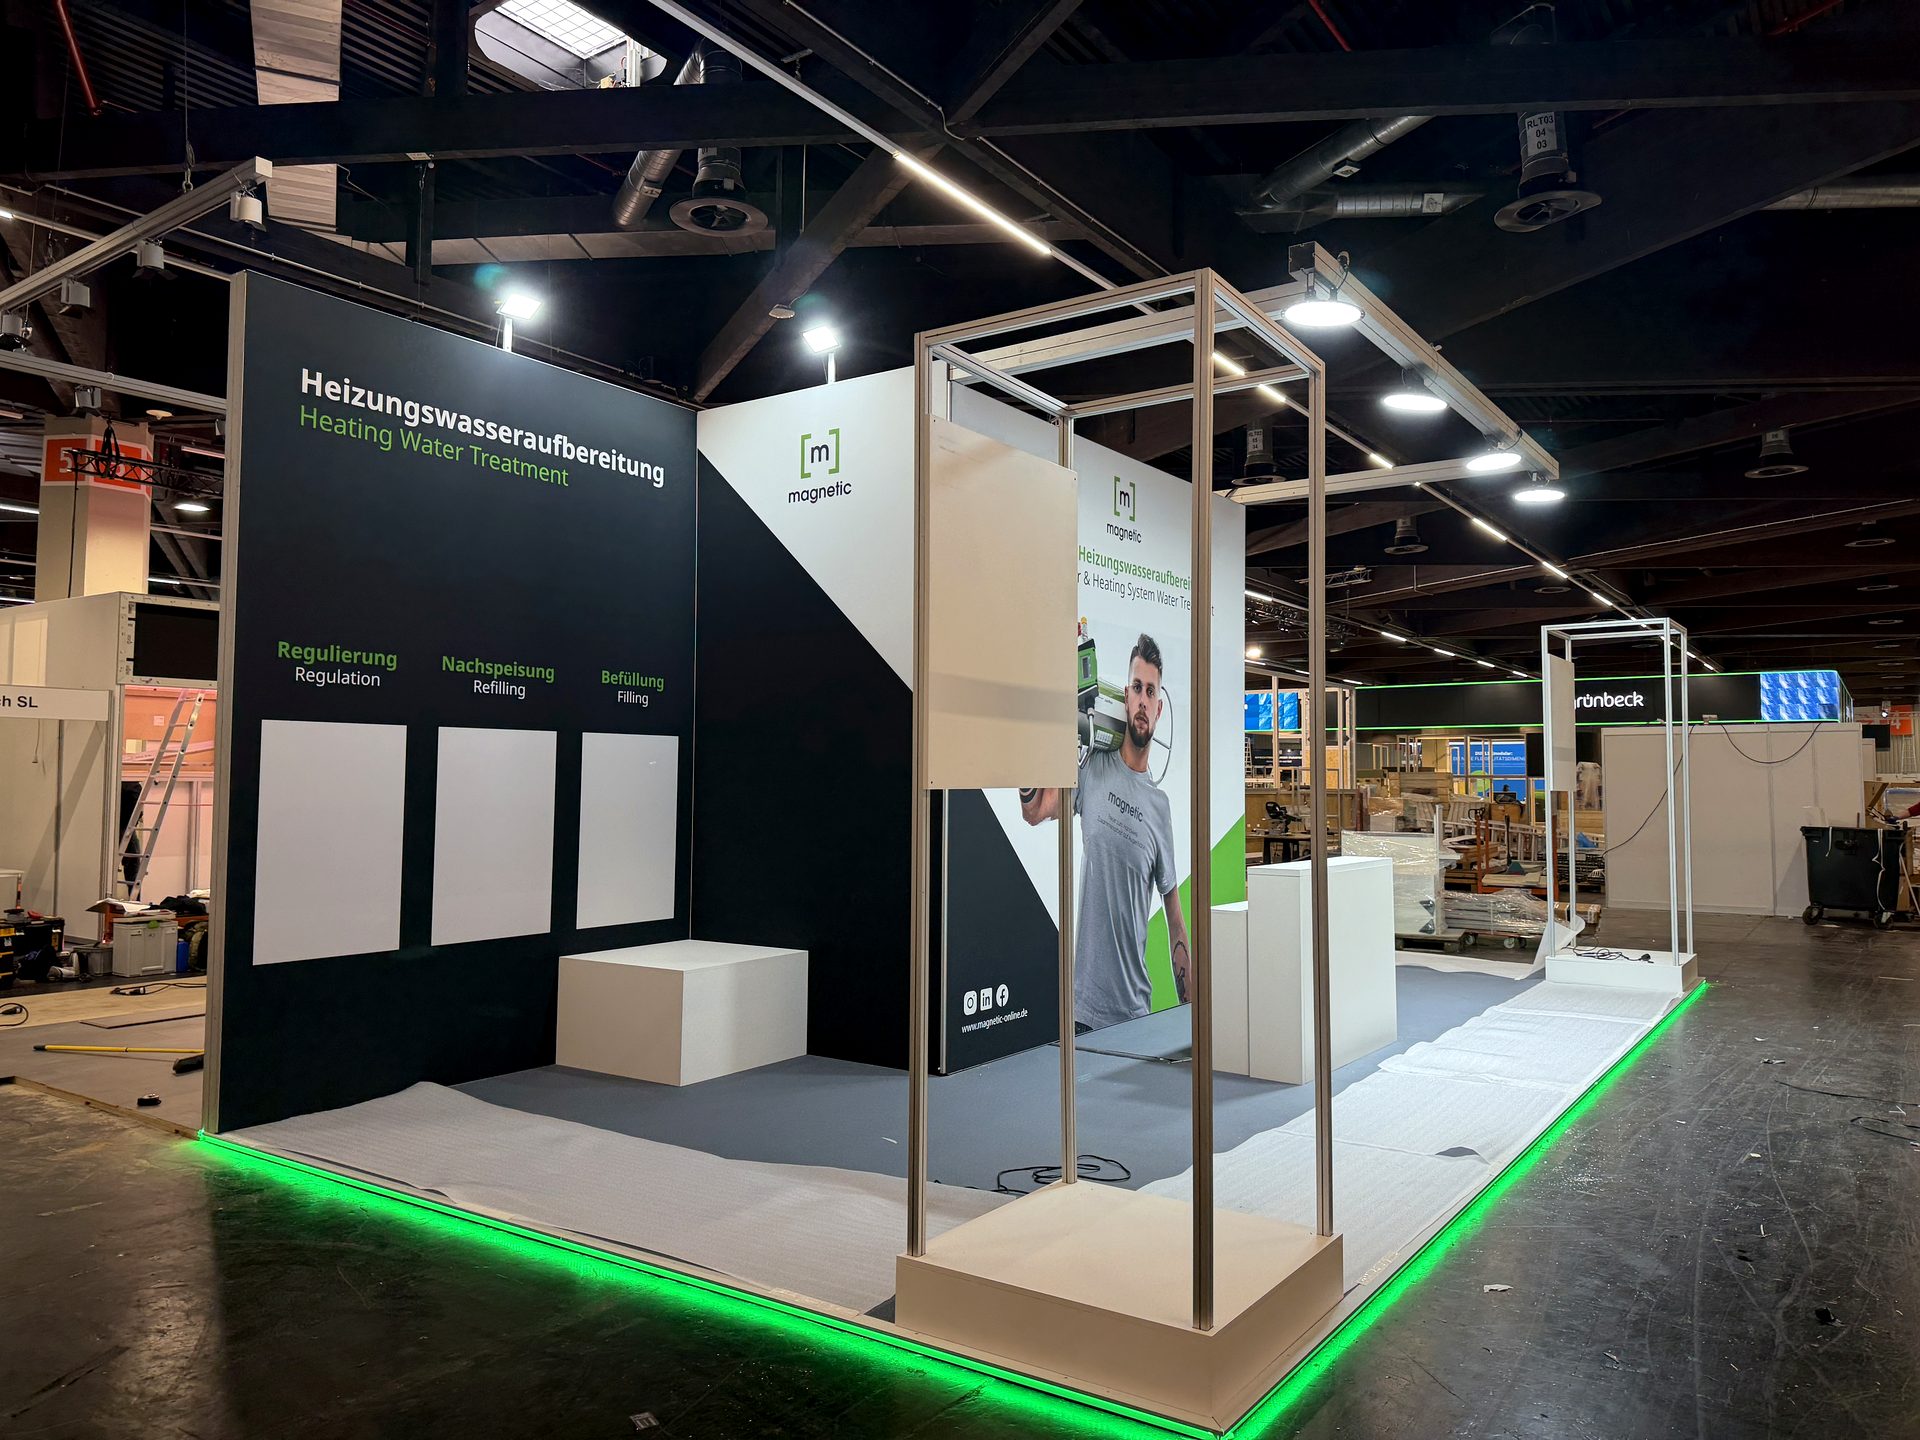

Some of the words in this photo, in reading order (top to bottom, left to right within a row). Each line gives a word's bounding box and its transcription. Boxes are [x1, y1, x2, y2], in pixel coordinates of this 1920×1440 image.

[1527, 115, 1554, 130] RLT03
[1535, 128, 1546, 138] 04
[1536, 139, 1547, 149] 03
[300, 368, 665, 488] Heizungswasseraufbereitung
[300, 405, 393, 451] Heating
[400, 427, 464, 461] Water
[469, 445, 569, 487] Treatment
[788, 481, 852, 504] magnetic
[1106, 522, 1142, 544] magnetic
[1078, 545, 1191, 590] Heizungswasseraufberei
[1083, 570, 1091, 586] &
[1092, 572, 1126, 599] Heating
[1127, 582, 1155, 602] System
[1156, 590, 1178, 608] Water
[277, 641, 398, 671] Regulierung
[294, 666, 381, 687] Regulation
[441, 655, 555, 683] Nachspeisung
[601, 669, 665, 692] Befüllung
[17, 695, 38, 708] SL
[473, 680, 527, 700] Refilling
[617, 690, 649, 708] Filling
[1574, 691, 1645, 710] rünbeck
[1107, 791, 1144, 822] magnetic
[961, 1008, 1028, 1034] www.magnetic-online.de
